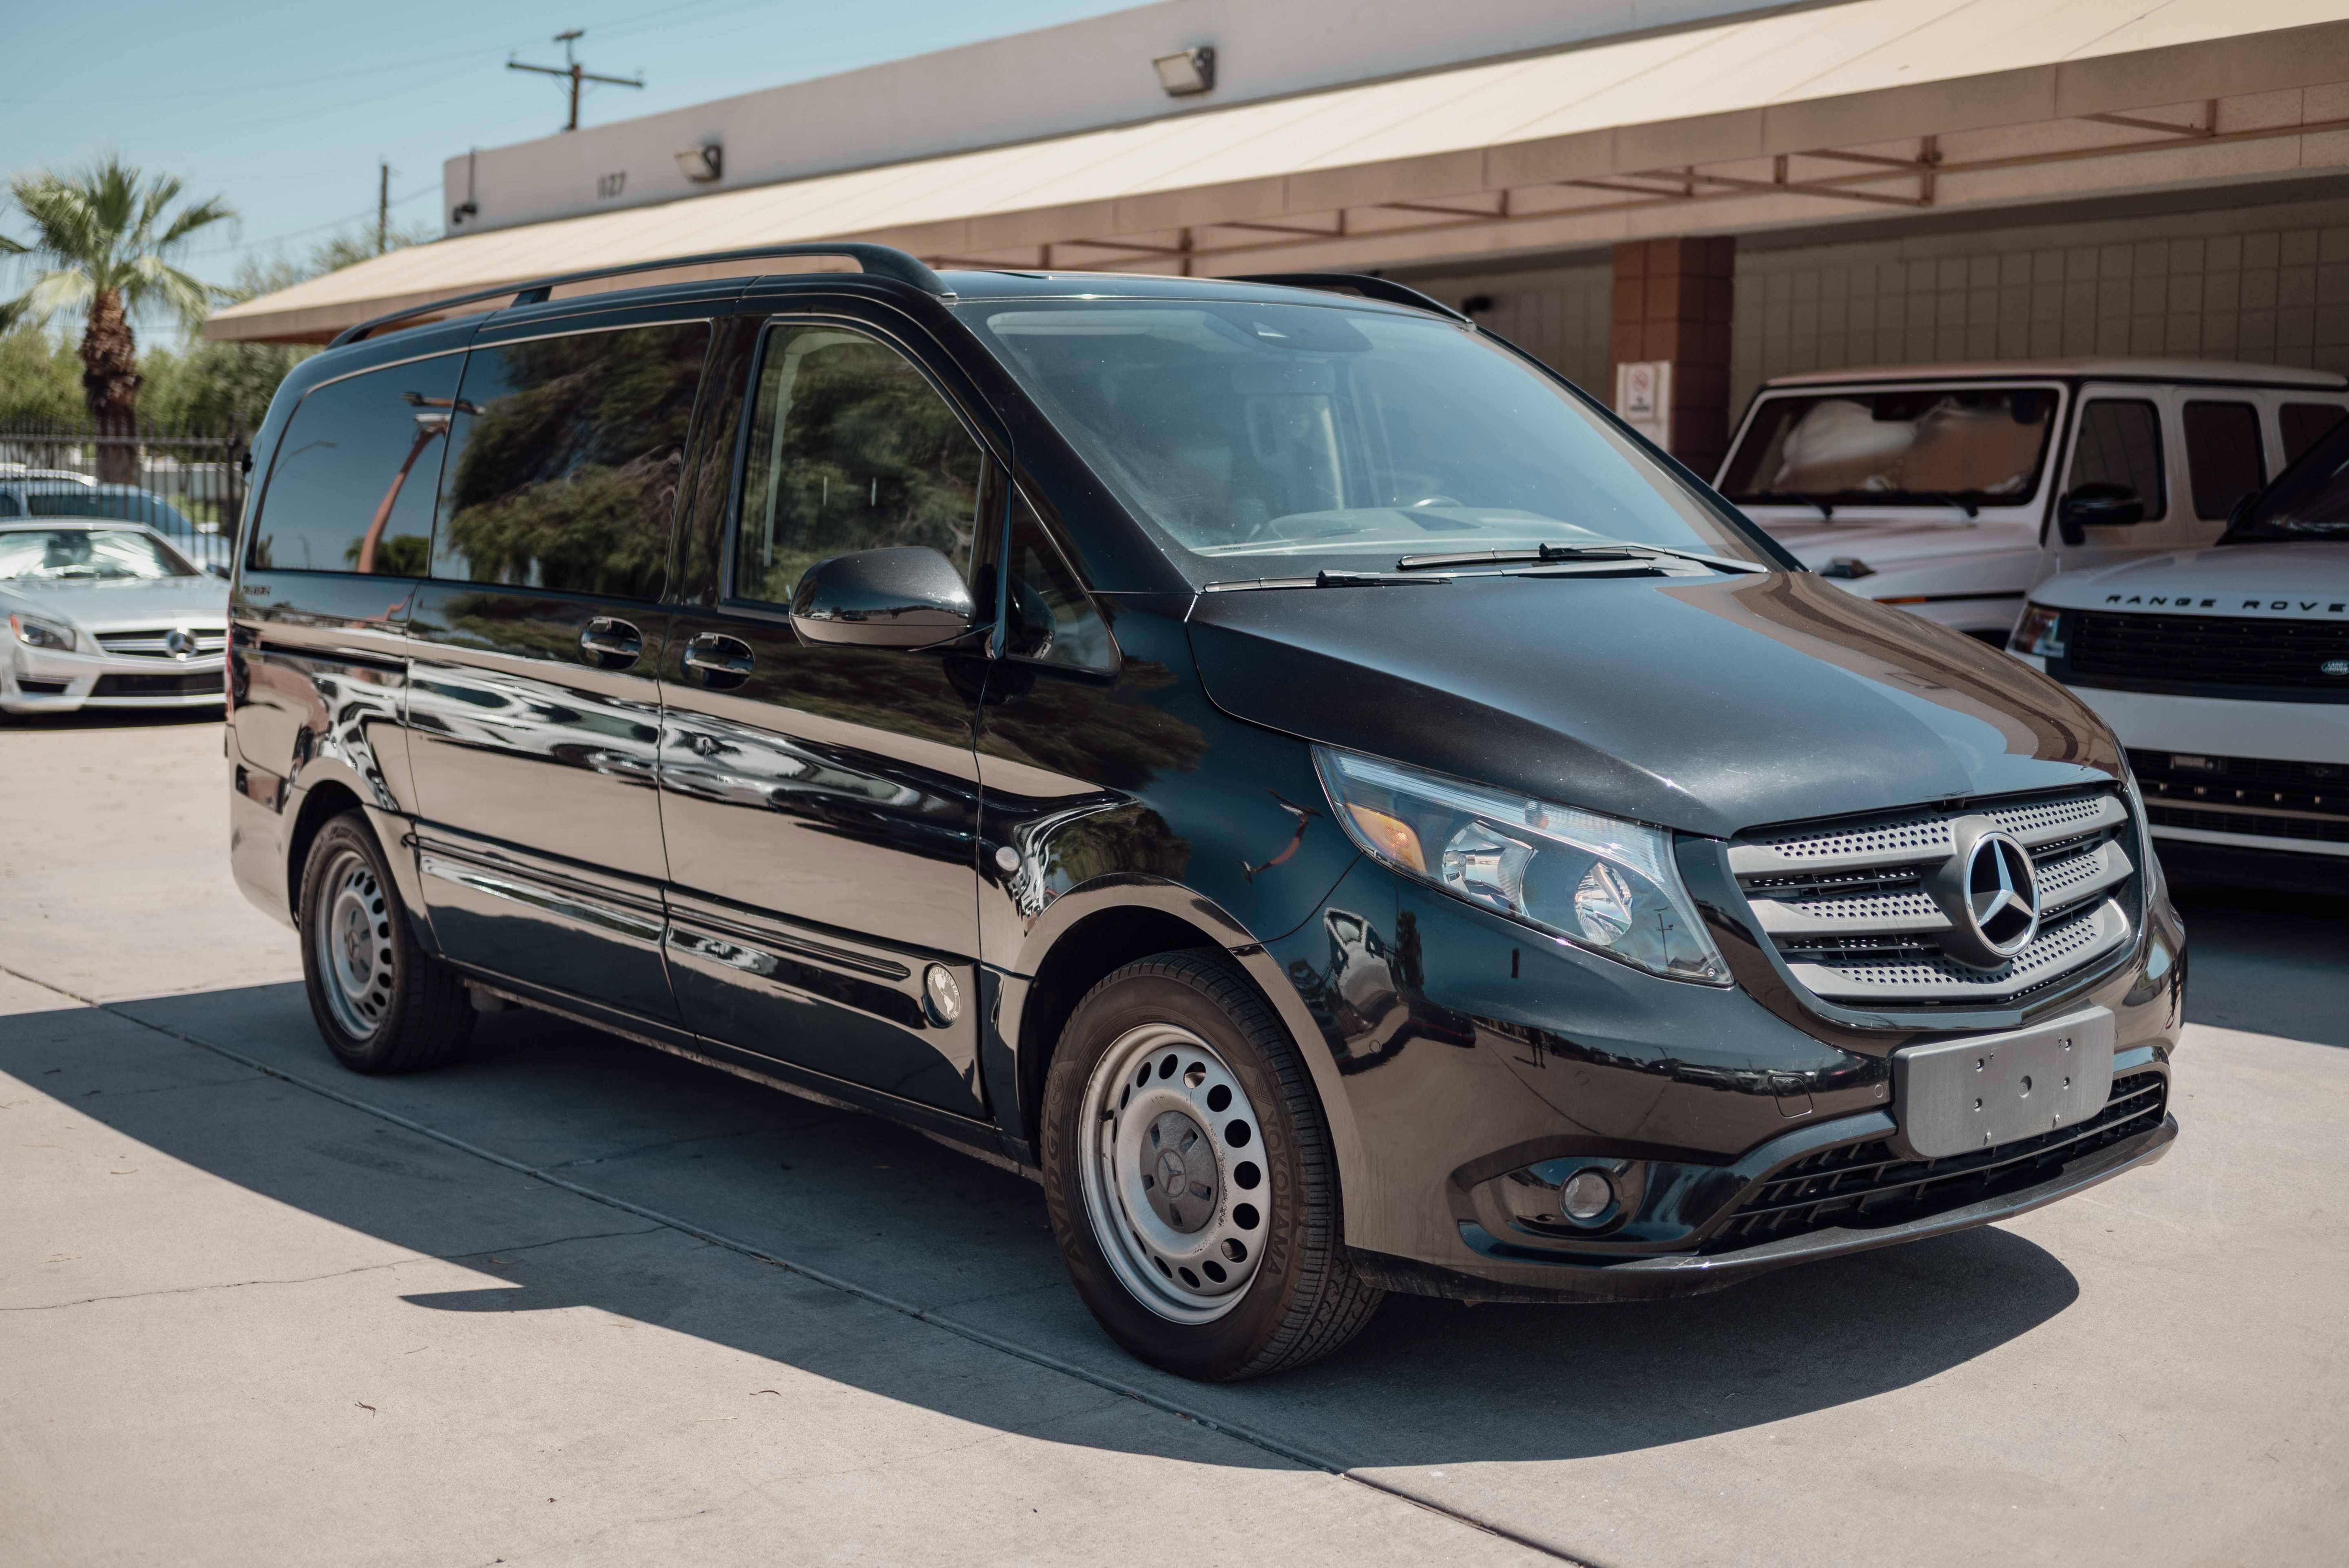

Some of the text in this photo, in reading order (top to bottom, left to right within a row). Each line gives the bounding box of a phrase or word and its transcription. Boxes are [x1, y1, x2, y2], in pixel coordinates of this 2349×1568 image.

[597, 170, 627, 201] 1127
[2106, 594, 2216, 608] RANGE
[1047, 1110, 1086, 1263] AVID GT
[1264, 1109, 1292, 1275] YOKOHAMA
